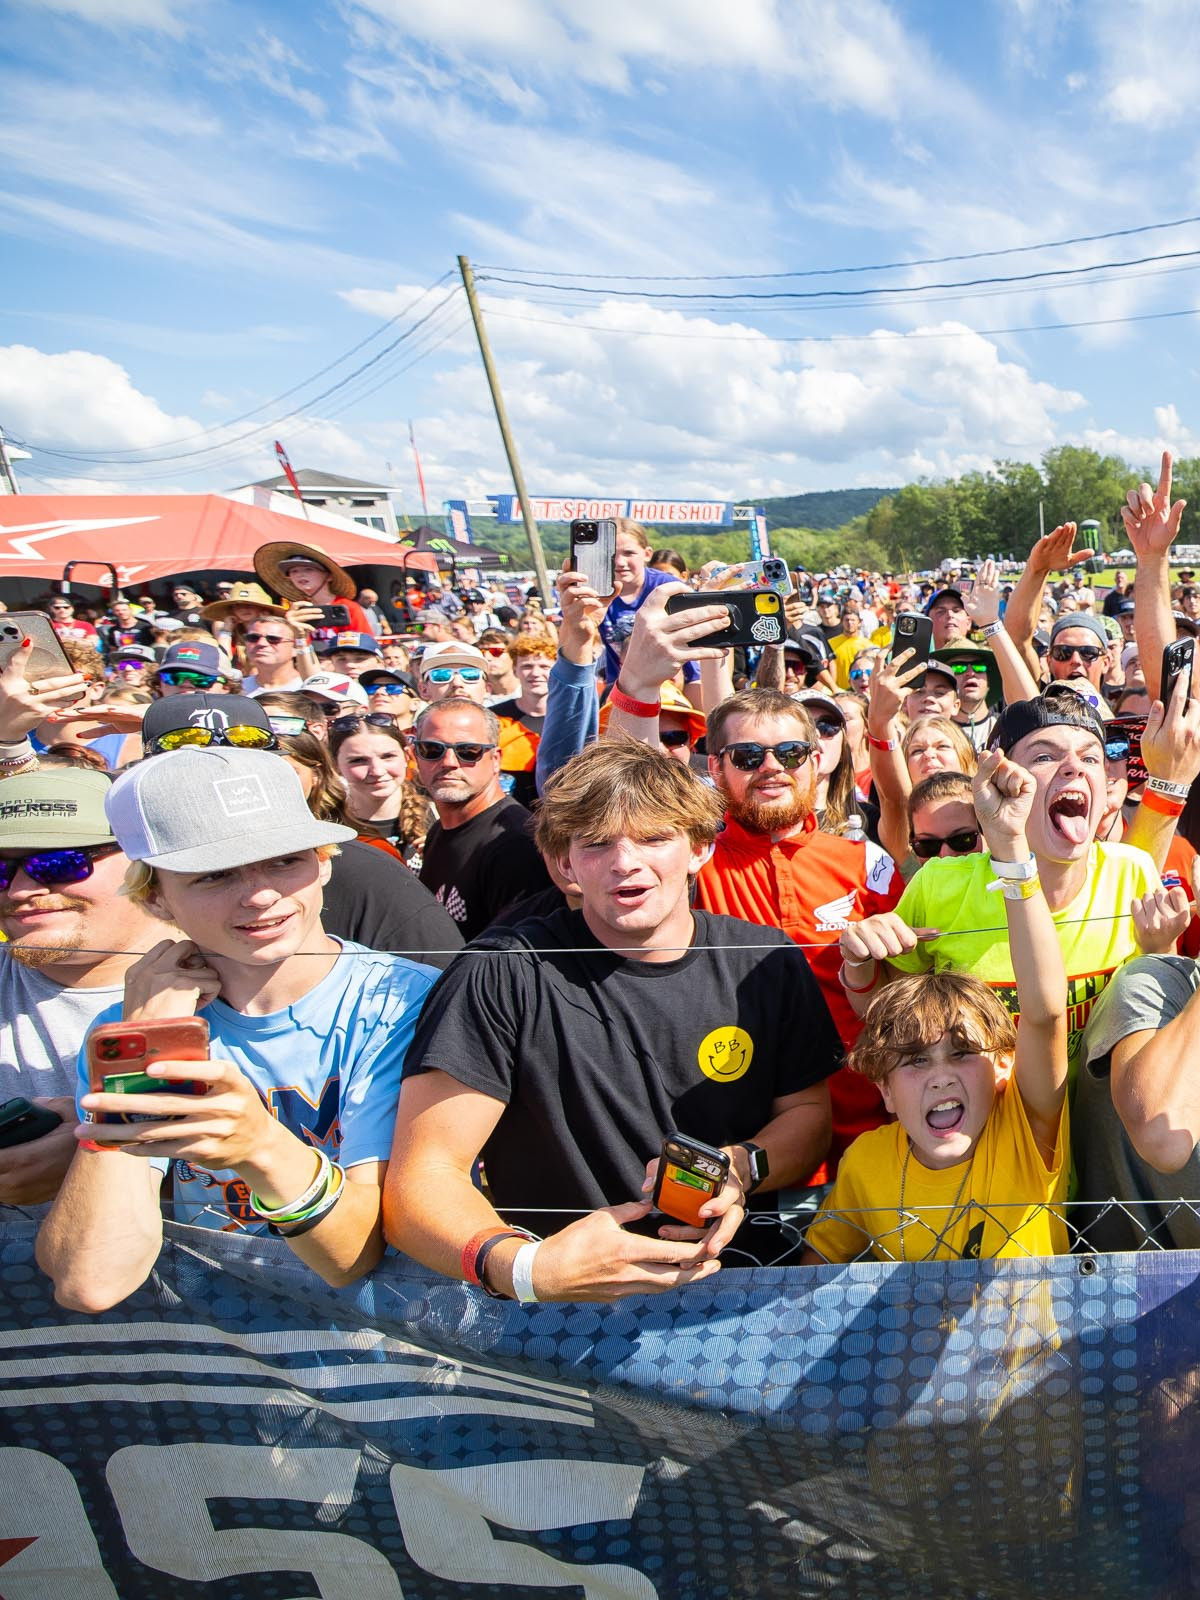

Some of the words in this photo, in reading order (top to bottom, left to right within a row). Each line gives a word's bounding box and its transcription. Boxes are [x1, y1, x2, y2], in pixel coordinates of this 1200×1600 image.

[631, 502, 725, 521] HOLESHOT
[815, 922, 857, 932] HON
[694, 1159, 721, 1176] 20
